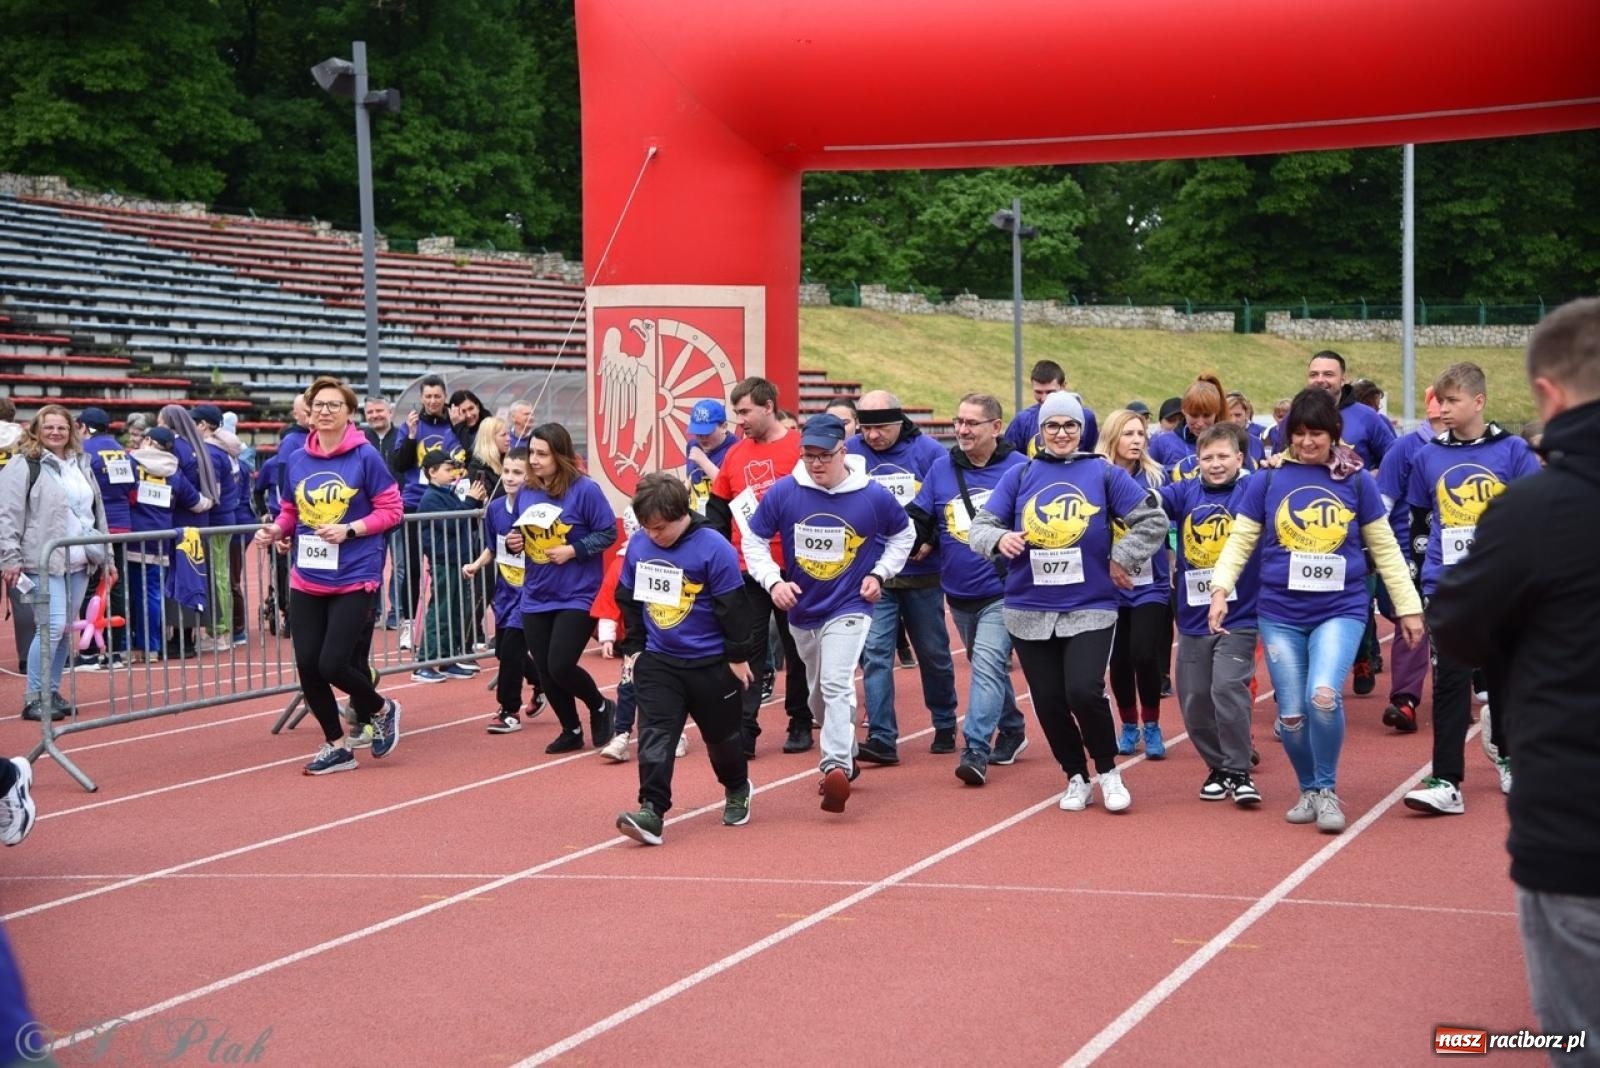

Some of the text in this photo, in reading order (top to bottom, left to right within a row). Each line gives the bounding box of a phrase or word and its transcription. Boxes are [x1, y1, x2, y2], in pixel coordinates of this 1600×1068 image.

[889, 485, 904, 495] 33
[805, 538, 833, 550] 029
[306, 547, 328, 558] 054
[1043, 561, 1070, 574] 077
[1302, 565, 1334, 579] 089
[648, 577, 671, 592] 158
